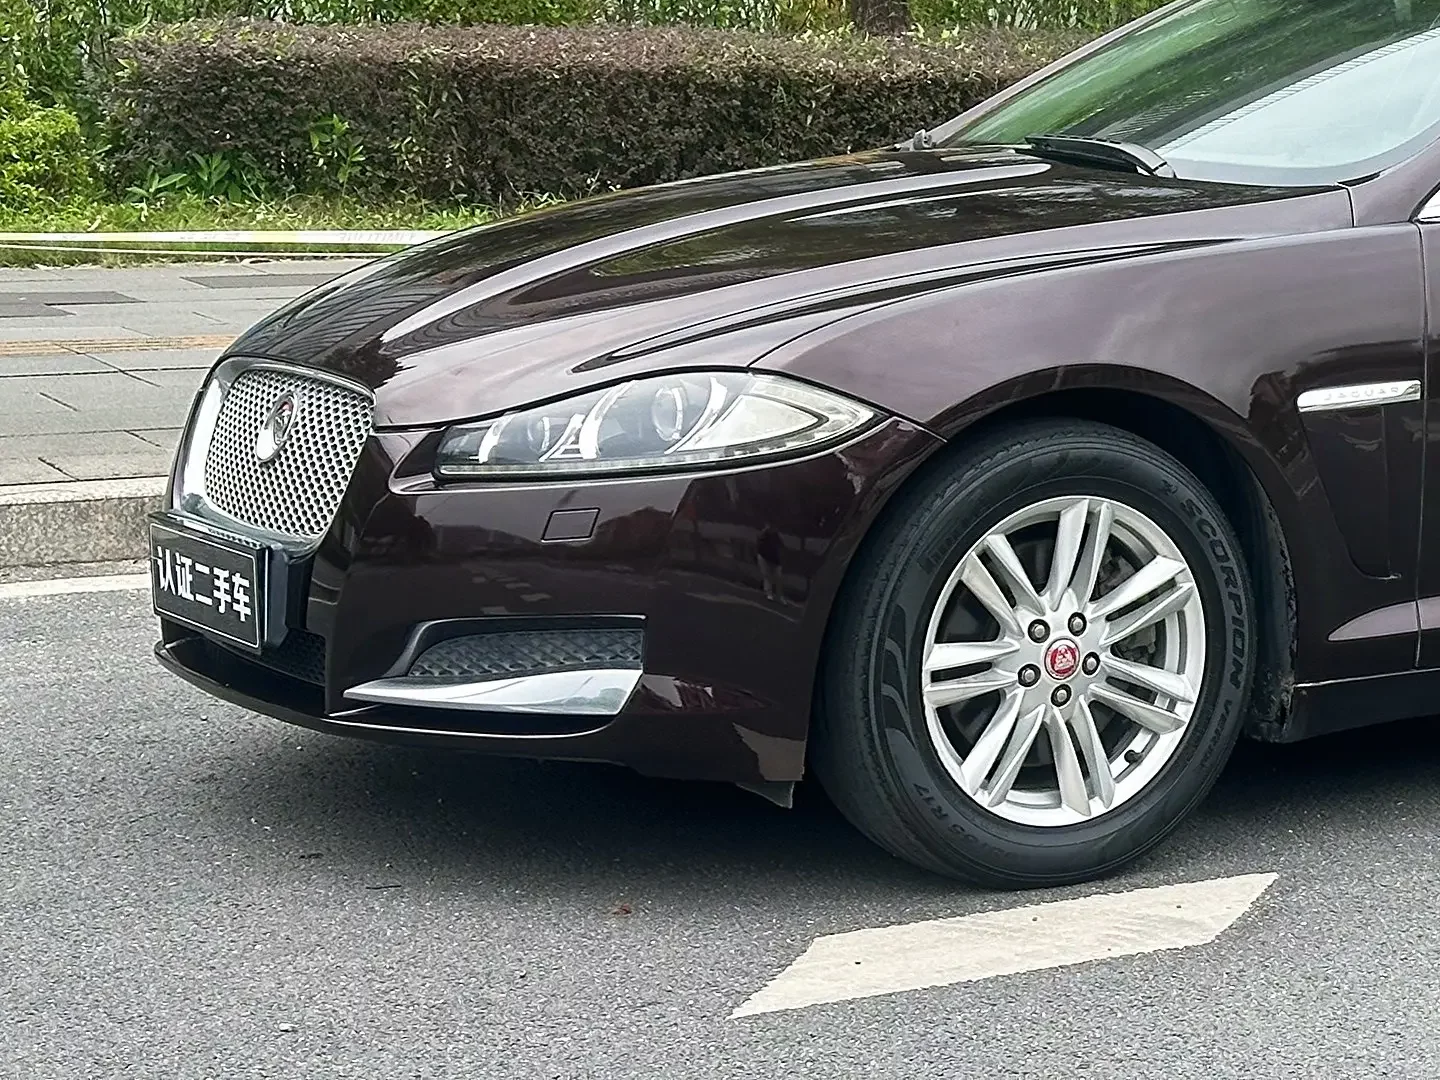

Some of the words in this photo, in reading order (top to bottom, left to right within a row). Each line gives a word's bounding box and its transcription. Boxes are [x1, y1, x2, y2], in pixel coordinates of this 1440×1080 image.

[152, 546, 251, 622] 认证二手车
[1180, 497, 1246, 689] SCORPION
